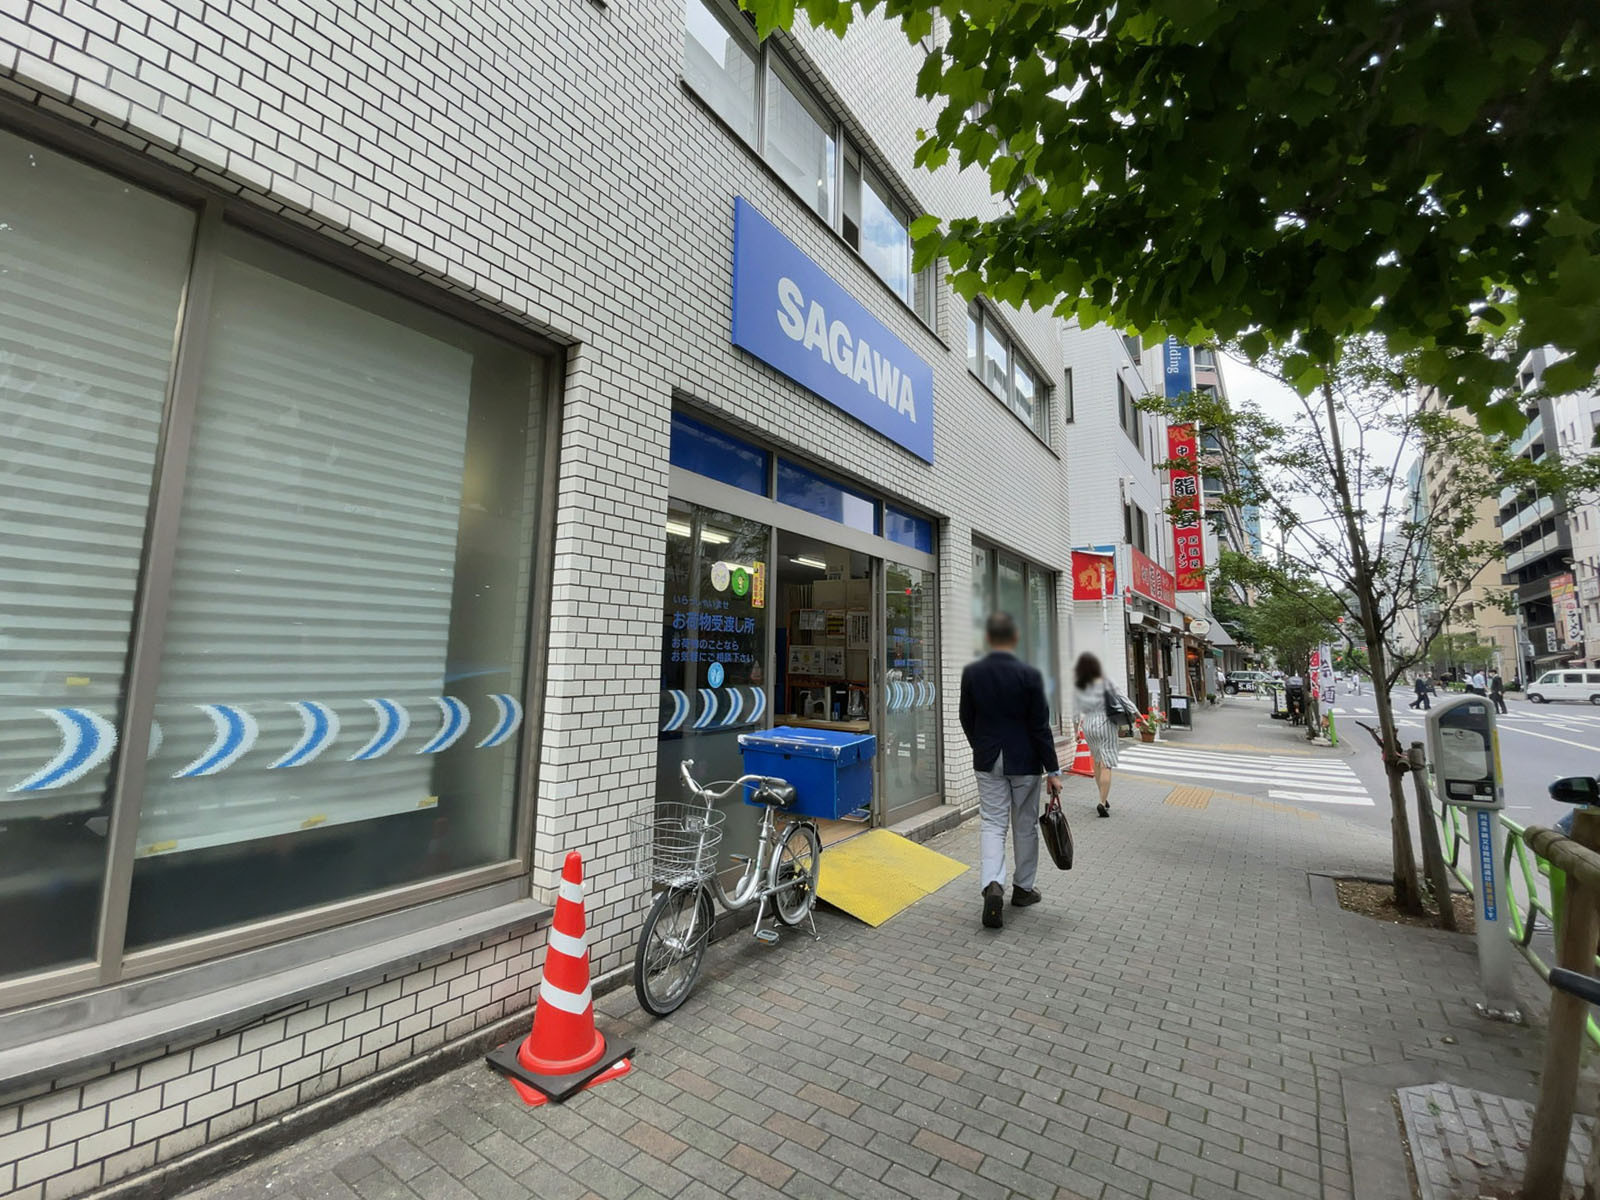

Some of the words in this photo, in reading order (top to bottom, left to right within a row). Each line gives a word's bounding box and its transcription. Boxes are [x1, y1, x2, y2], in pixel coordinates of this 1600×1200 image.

[776, 276, 916, 423] SAGAWA
[1166, 334, 1182, 374] uilding
[1177, 536, 1188, 569] ラーメン
[672, 611, 755, 634] お荷物受渡し所
[1567, 610, 1581, 640] ラーメン
